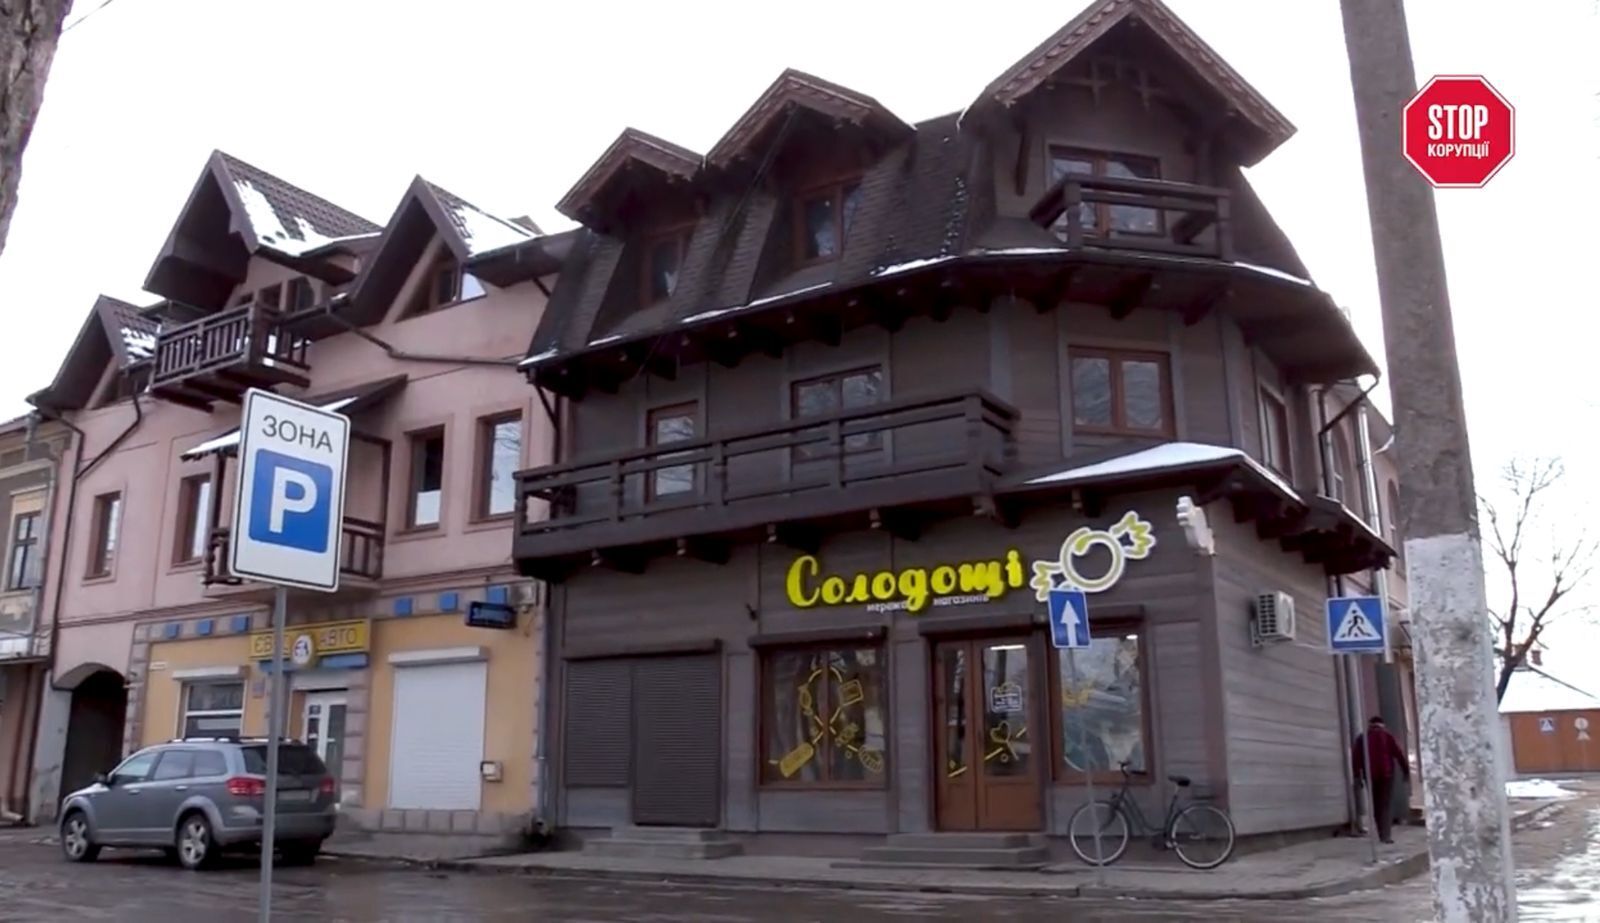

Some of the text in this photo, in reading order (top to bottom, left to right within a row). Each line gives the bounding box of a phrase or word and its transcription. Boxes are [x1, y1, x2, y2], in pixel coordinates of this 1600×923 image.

[262, 415, 333, 453] ЗОНА
[786, 550, 1023, 611] Солодощі
[319, 628, 357, 648] АВТО
